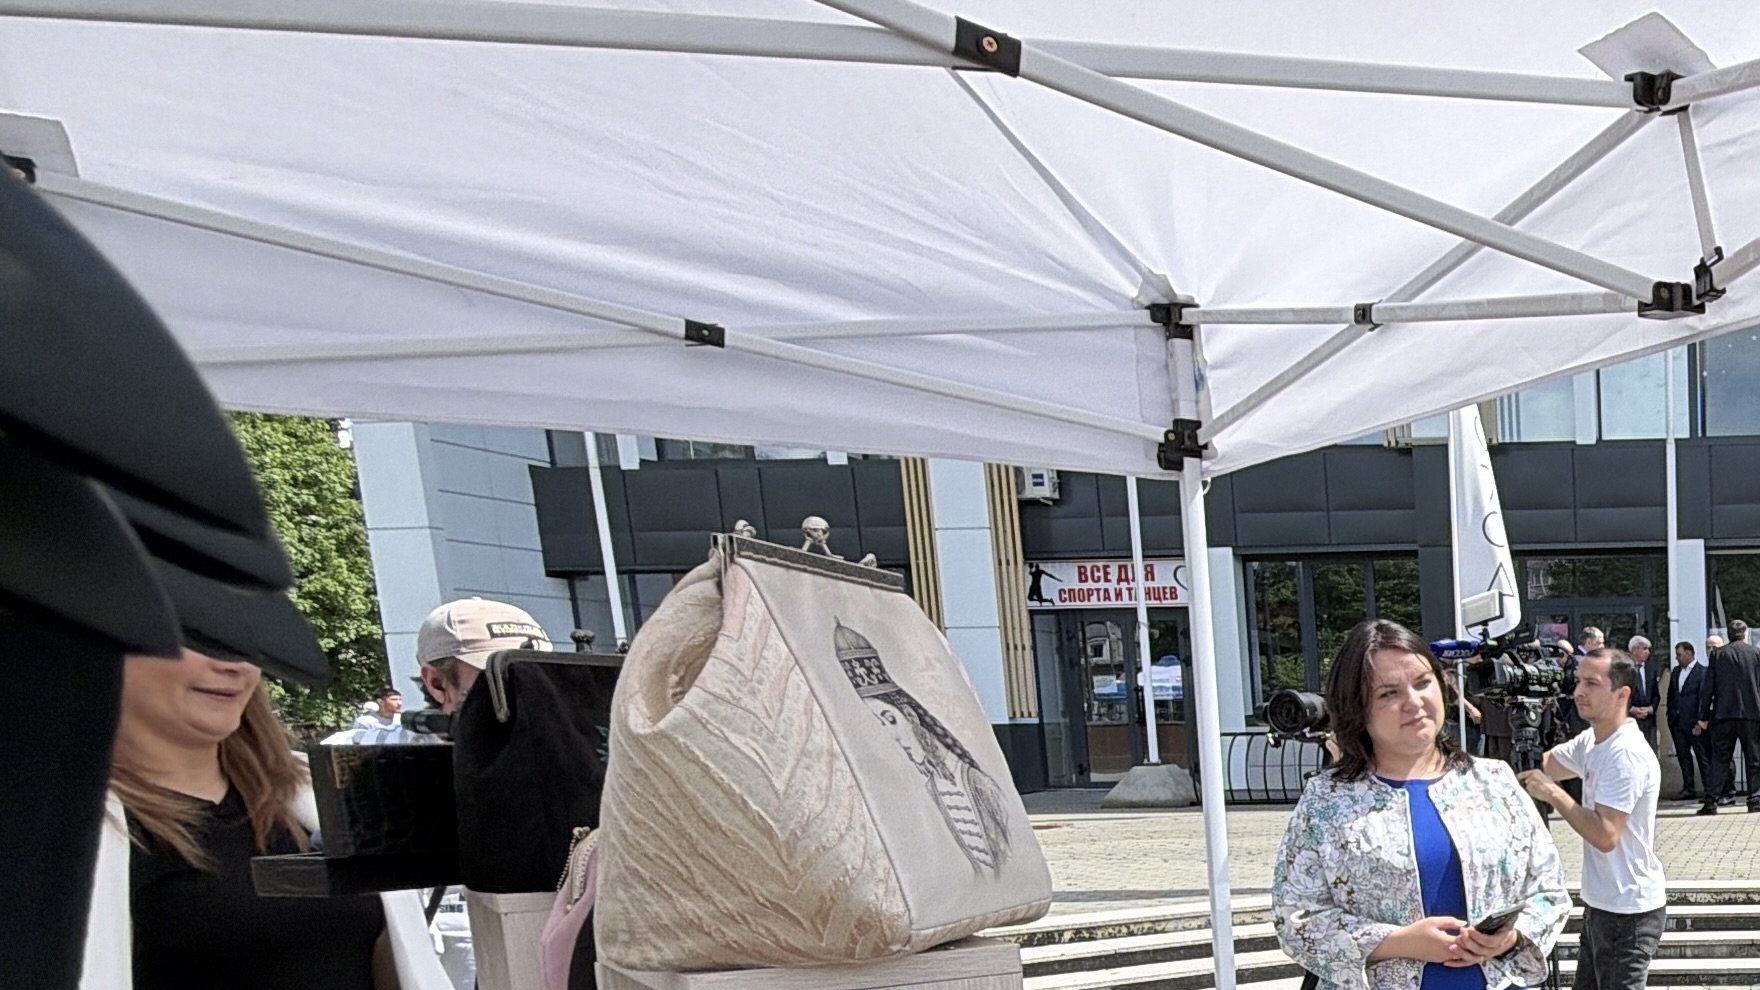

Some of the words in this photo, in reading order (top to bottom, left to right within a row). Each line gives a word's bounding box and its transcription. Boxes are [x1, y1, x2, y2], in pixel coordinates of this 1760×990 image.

[1077, 564, 1112, 584] ВСЕ
[1058, 587, 1112, 604] СПОРТА
[1114, 588, 1123, 602] И
[1124, 586, 1178, 604] ТНЦЕВ
